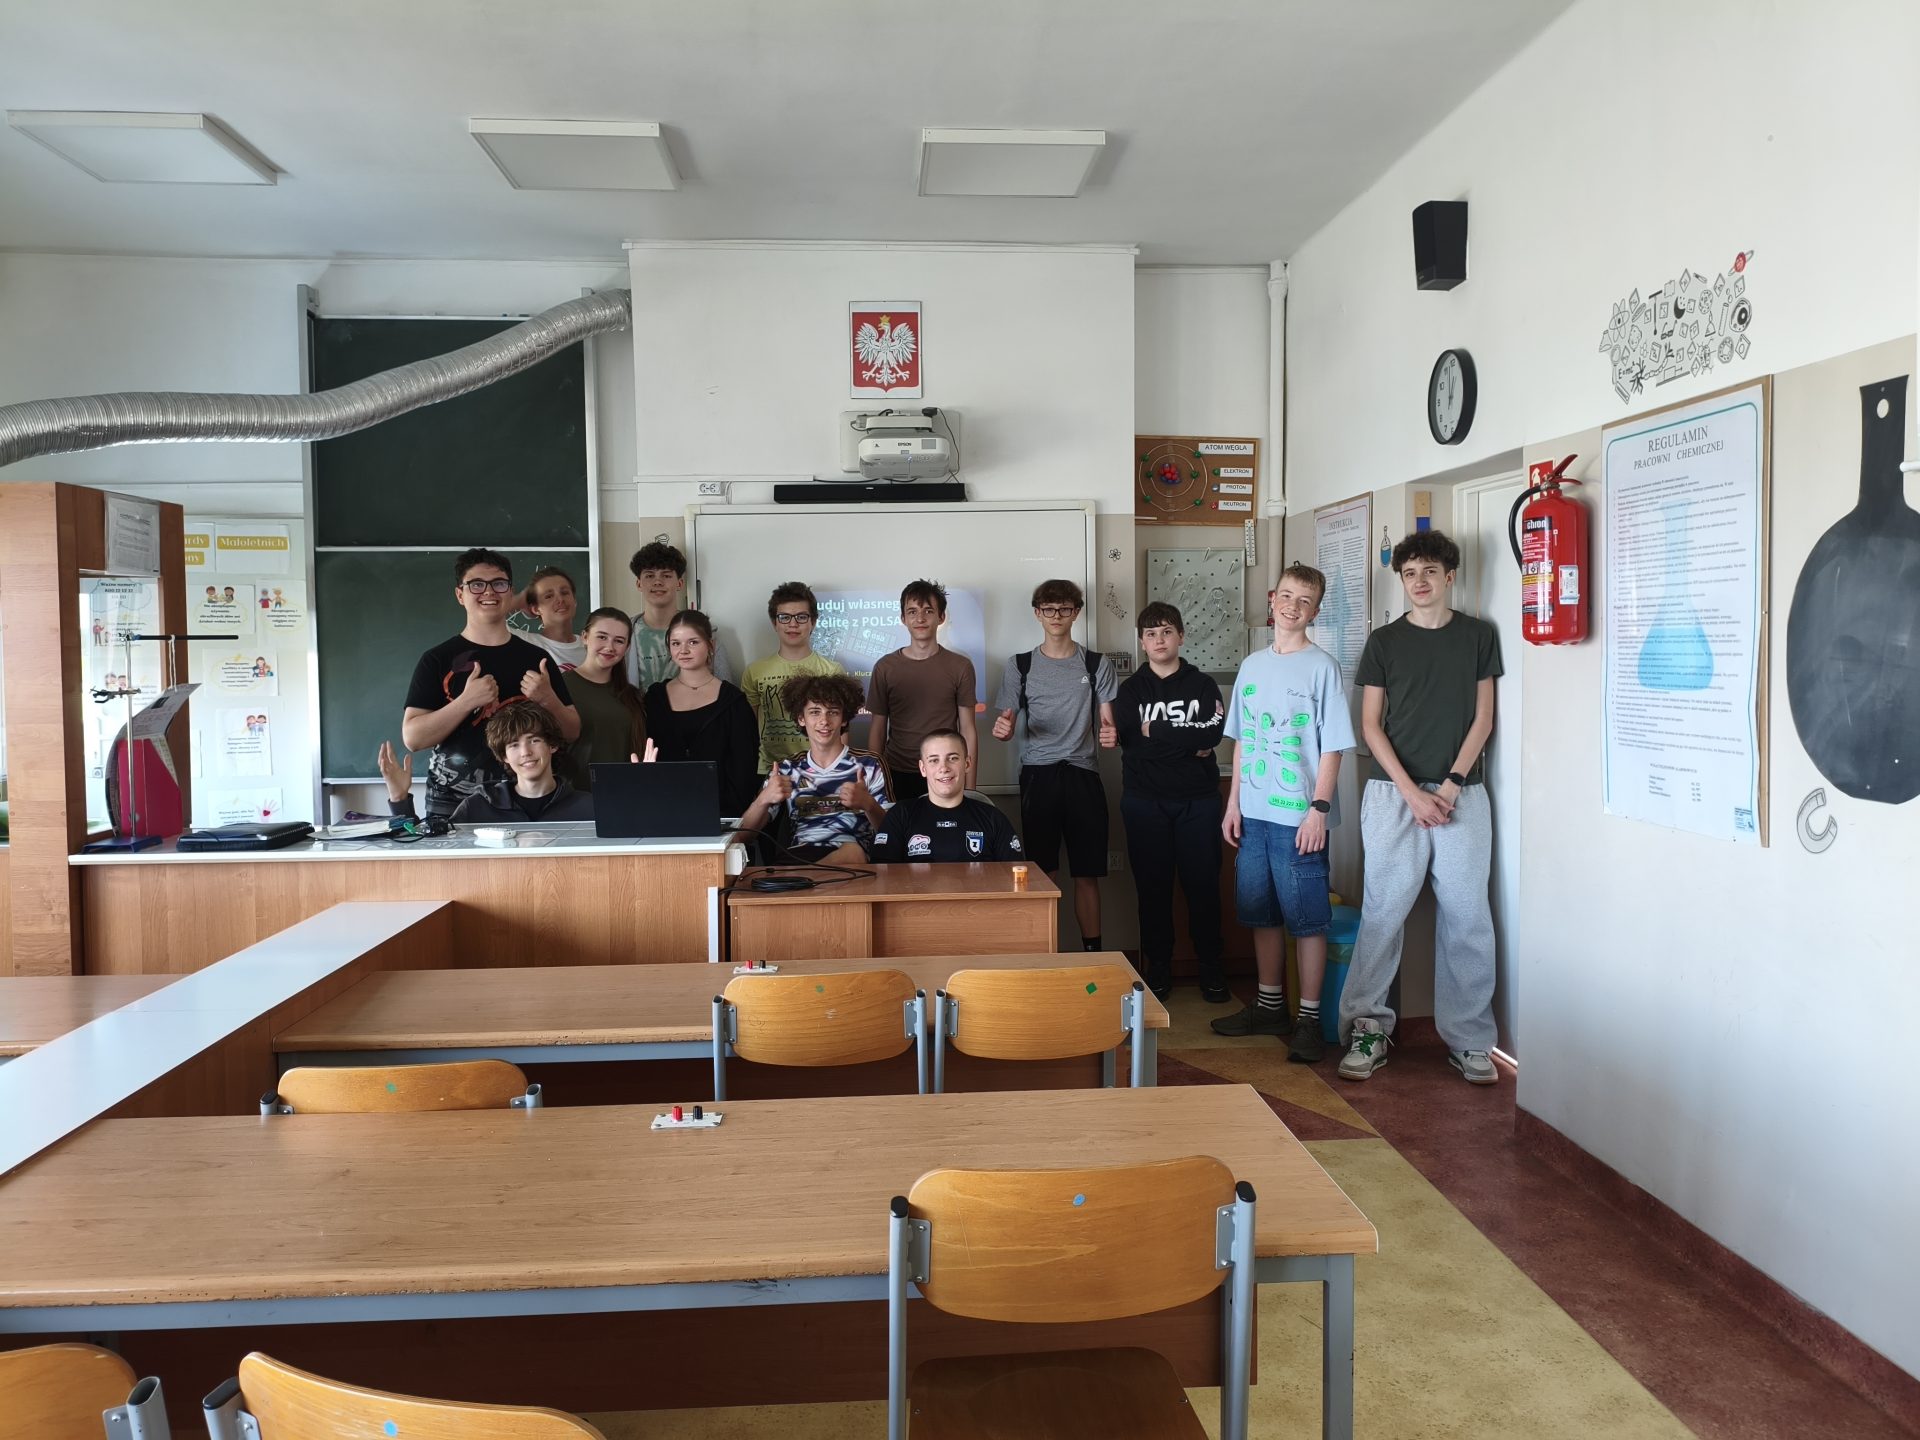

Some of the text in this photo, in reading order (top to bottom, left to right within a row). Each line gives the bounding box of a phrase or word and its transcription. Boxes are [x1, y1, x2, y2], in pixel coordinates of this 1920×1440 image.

[1224, 444, 1248, 452] WĘGLA
[1648, 425, 1709, 453] REGULAMIN
[1633, 439, 1724, 470] PRACOWNI CHEMICZNEJ
[816, 599, 901, 613] uduj własneg
[816, 616, 904, 631] telitę z POLSA
[1138, 699, 1200, 723] NASA
